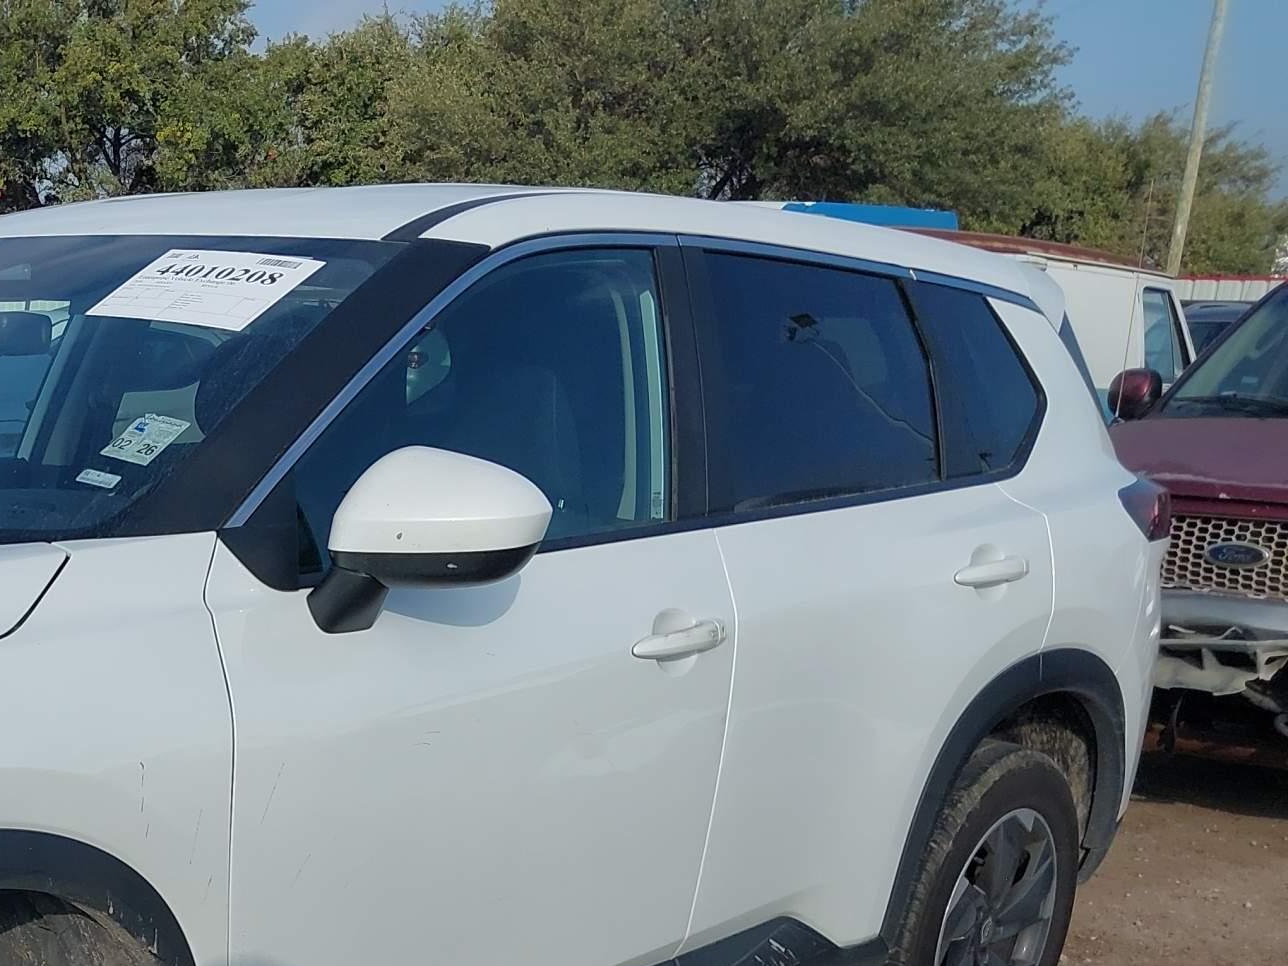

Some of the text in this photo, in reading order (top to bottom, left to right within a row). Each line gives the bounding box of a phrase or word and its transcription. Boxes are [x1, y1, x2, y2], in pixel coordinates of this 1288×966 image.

[156, 263, 284, 286] 44010208
[111, 437, 158, 456] 02 26
